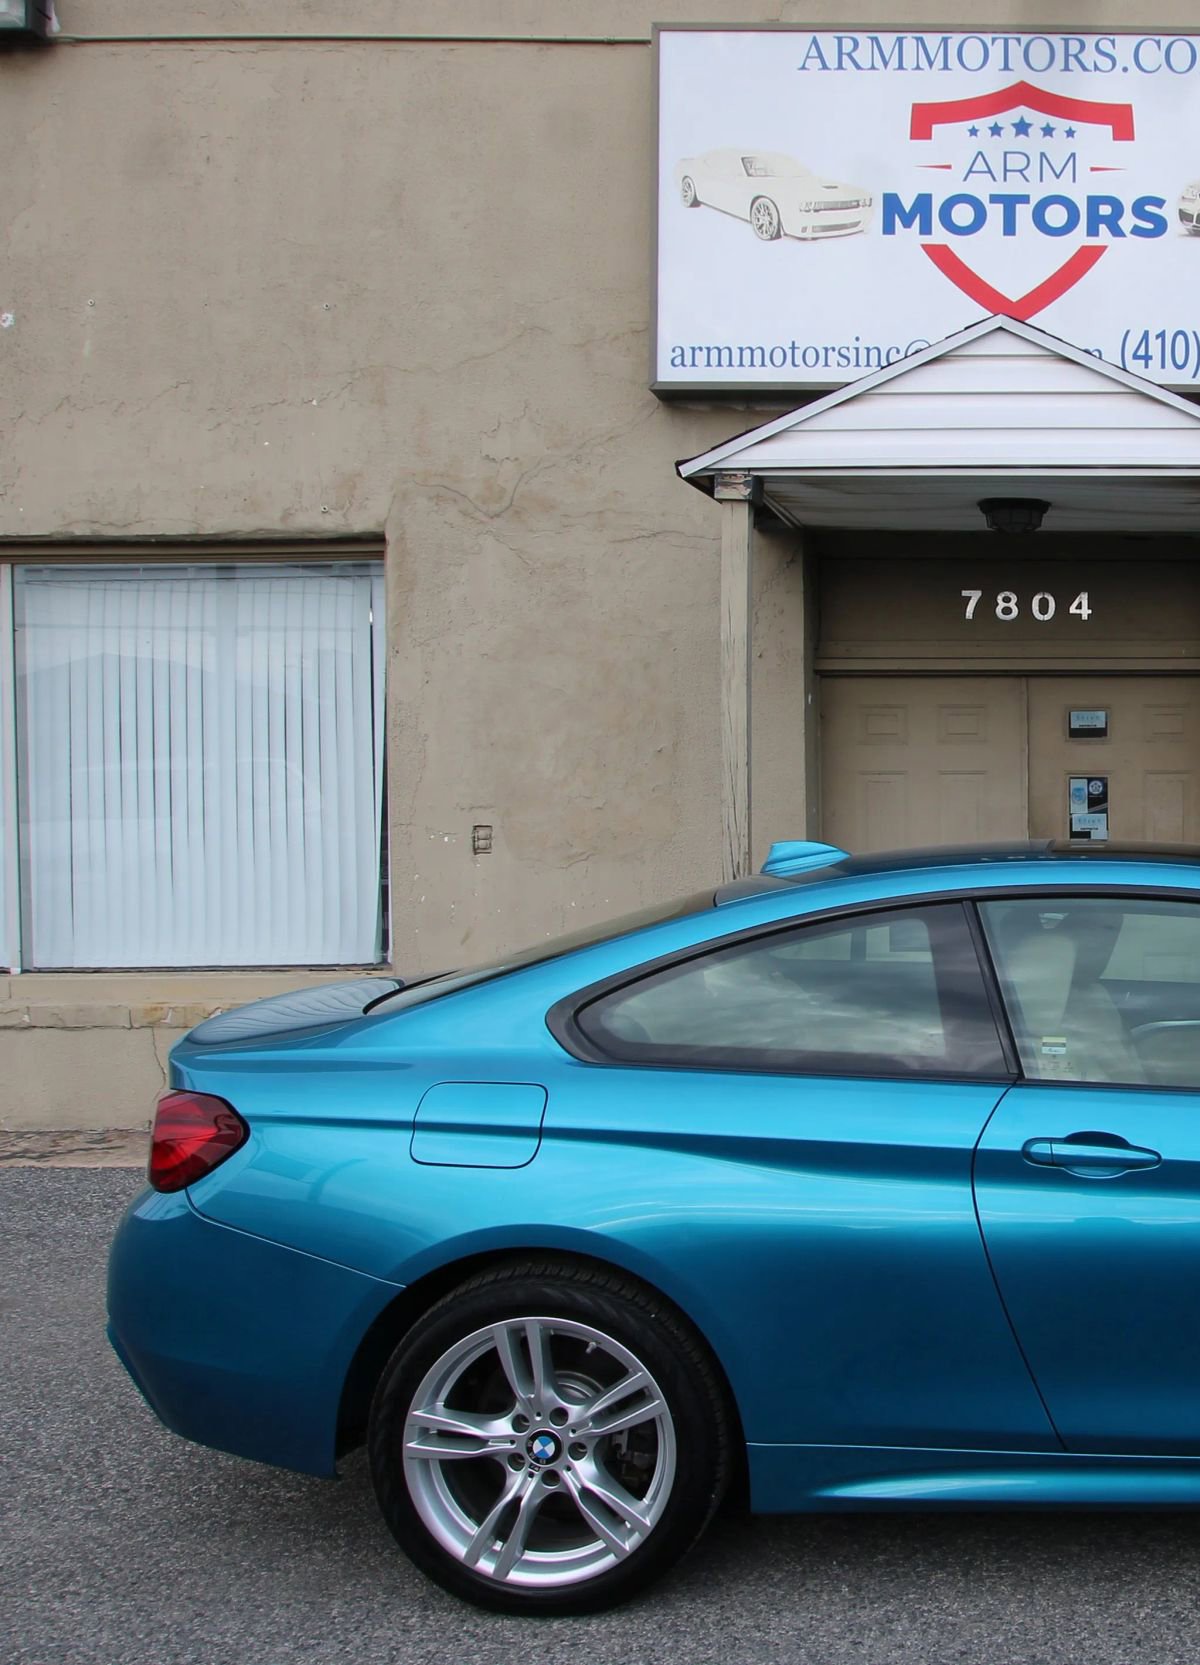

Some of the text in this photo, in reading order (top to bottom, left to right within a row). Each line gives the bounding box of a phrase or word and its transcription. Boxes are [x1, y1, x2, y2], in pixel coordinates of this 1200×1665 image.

[961, 149, 1078, 184] ARM
[881, 191, 1169, 239] MOTORS
[960, 589, 1093, 621] 7804
